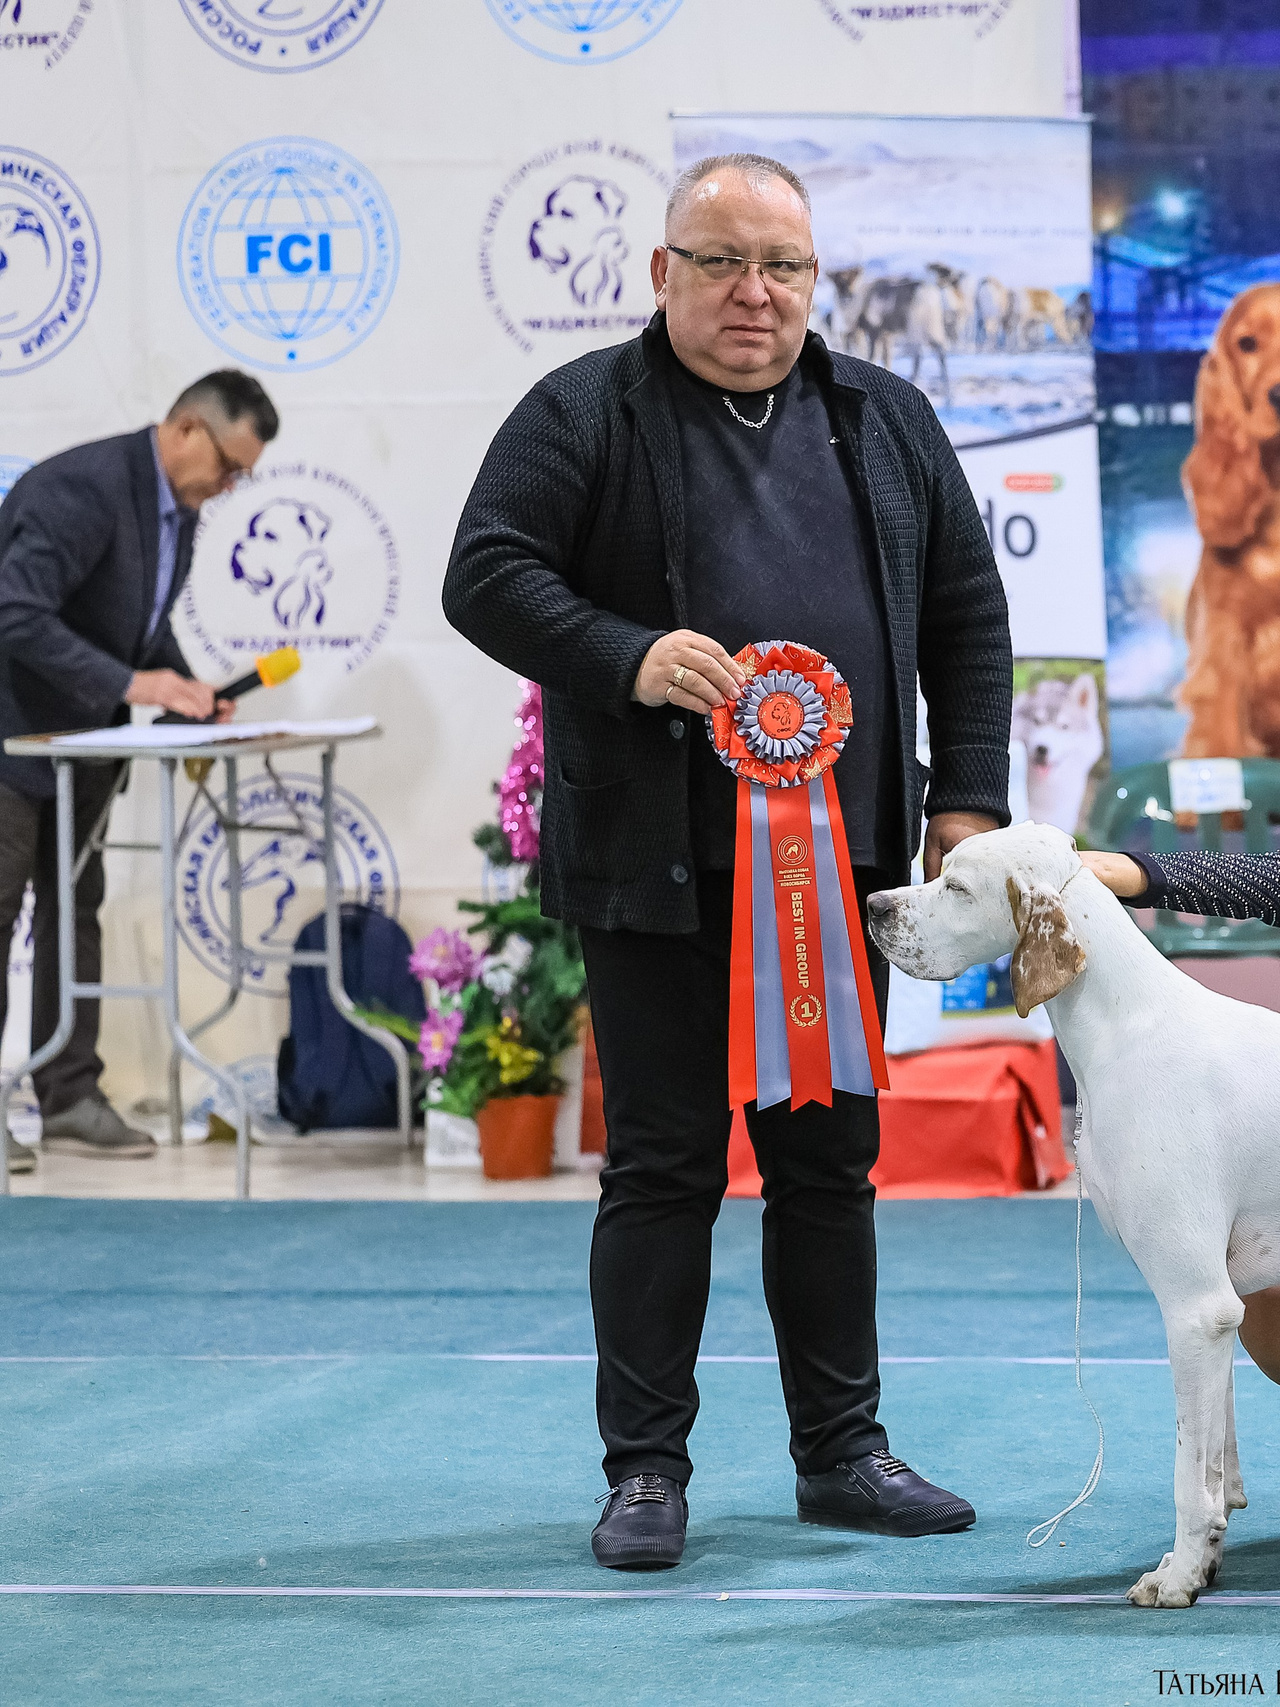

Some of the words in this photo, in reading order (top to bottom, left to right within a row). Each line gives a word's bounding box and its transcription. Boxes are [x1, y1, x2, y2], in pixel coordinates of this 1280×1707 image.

[246, 232, 331, 276] FCI
[791, 891, 804, 923] BEST
[794, 926, 806, 940] IN
[795, 943, 810, 989] GROUP
[800, 1002, 813, 1018] 1
